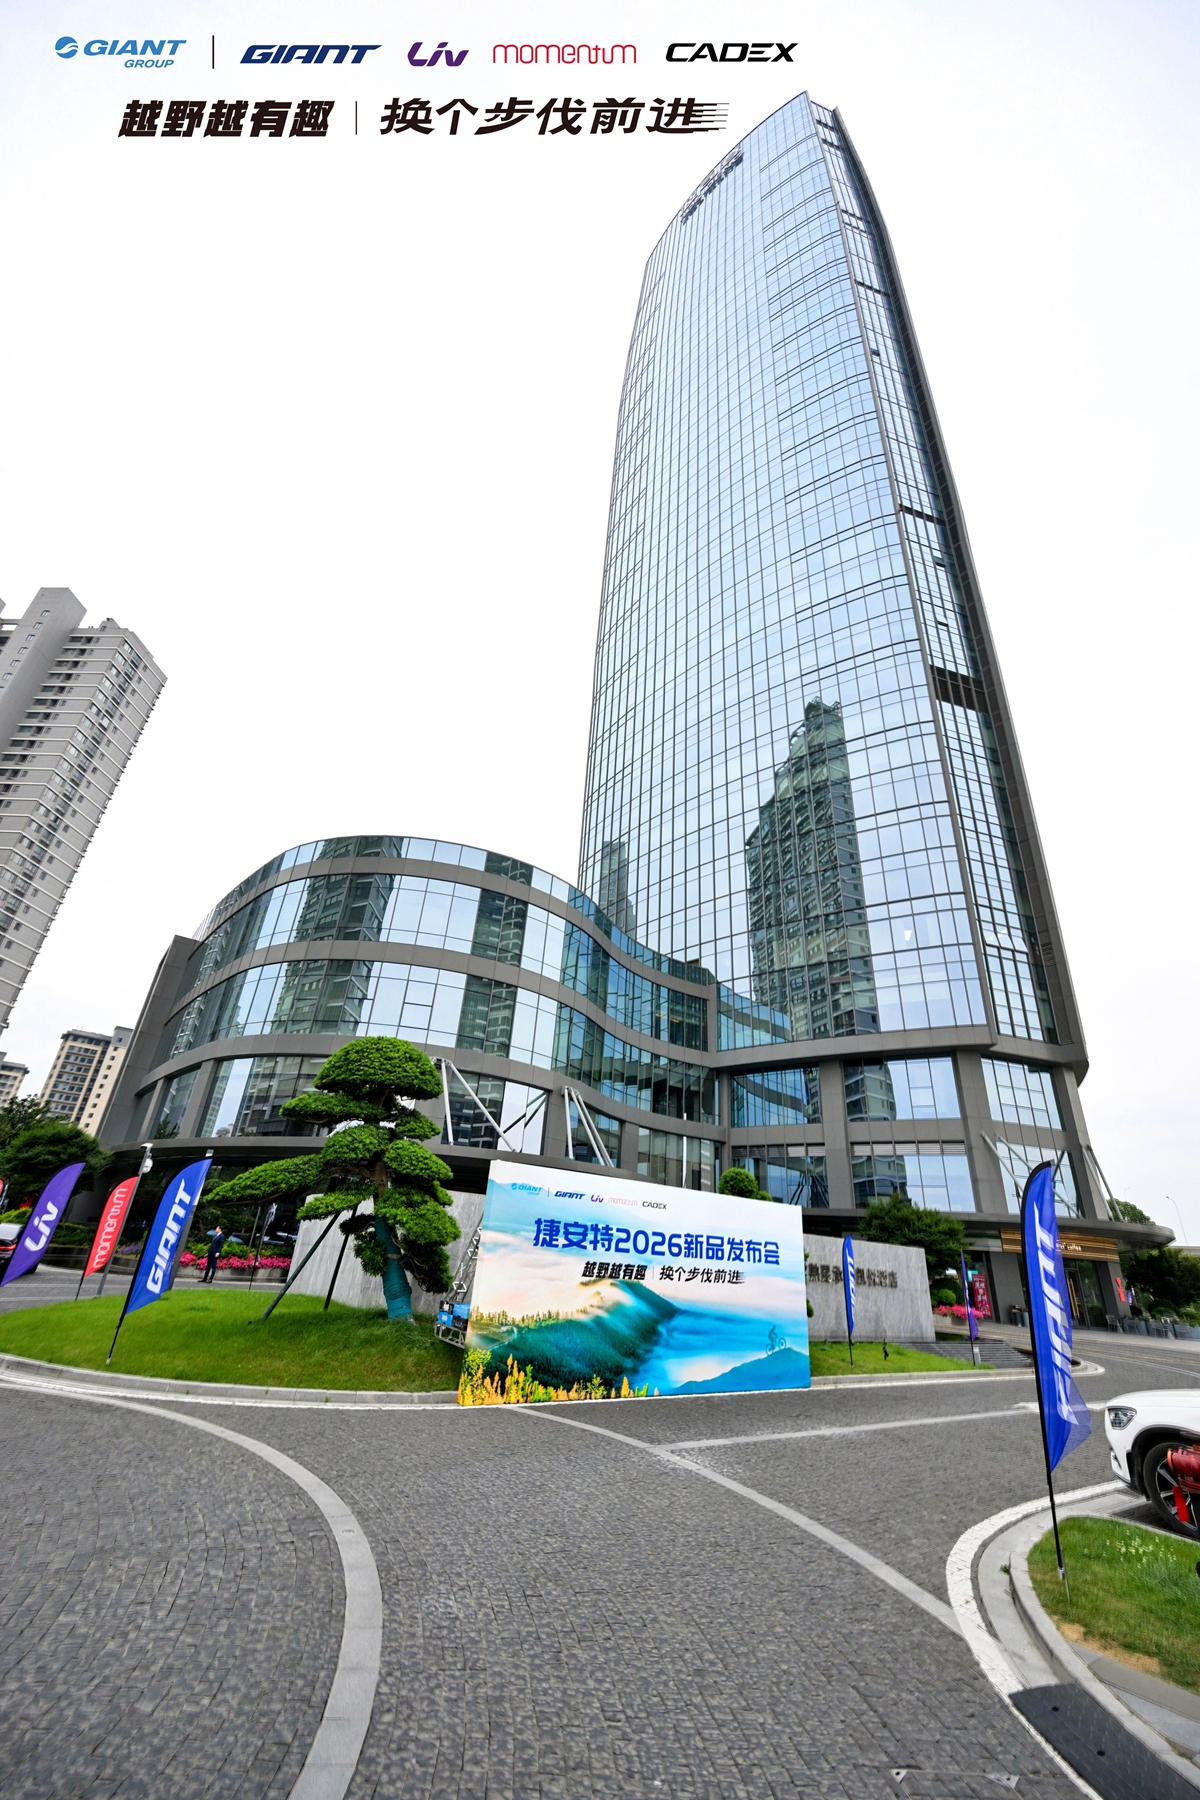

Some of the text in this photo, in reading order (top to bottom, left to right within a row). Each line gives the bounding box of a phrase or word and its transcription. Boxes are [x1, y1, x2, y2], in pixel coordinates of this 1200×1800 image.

[554, 1190, 586, 1200] GIANT
[590, 1194, 604, 1203] Liv
[642, 1200, 667, 1210] CADEX
[24, 1201, 59, 1252] Liv
[93, 1187, 129, 1269] momentum
[146, 1178, 192, 1295] GIANT
[533, 1217, 780, 1266] 捷安特2026新品发布会
[582, 1260, 746, 1285] 越野越有趣 换个步伐前进
